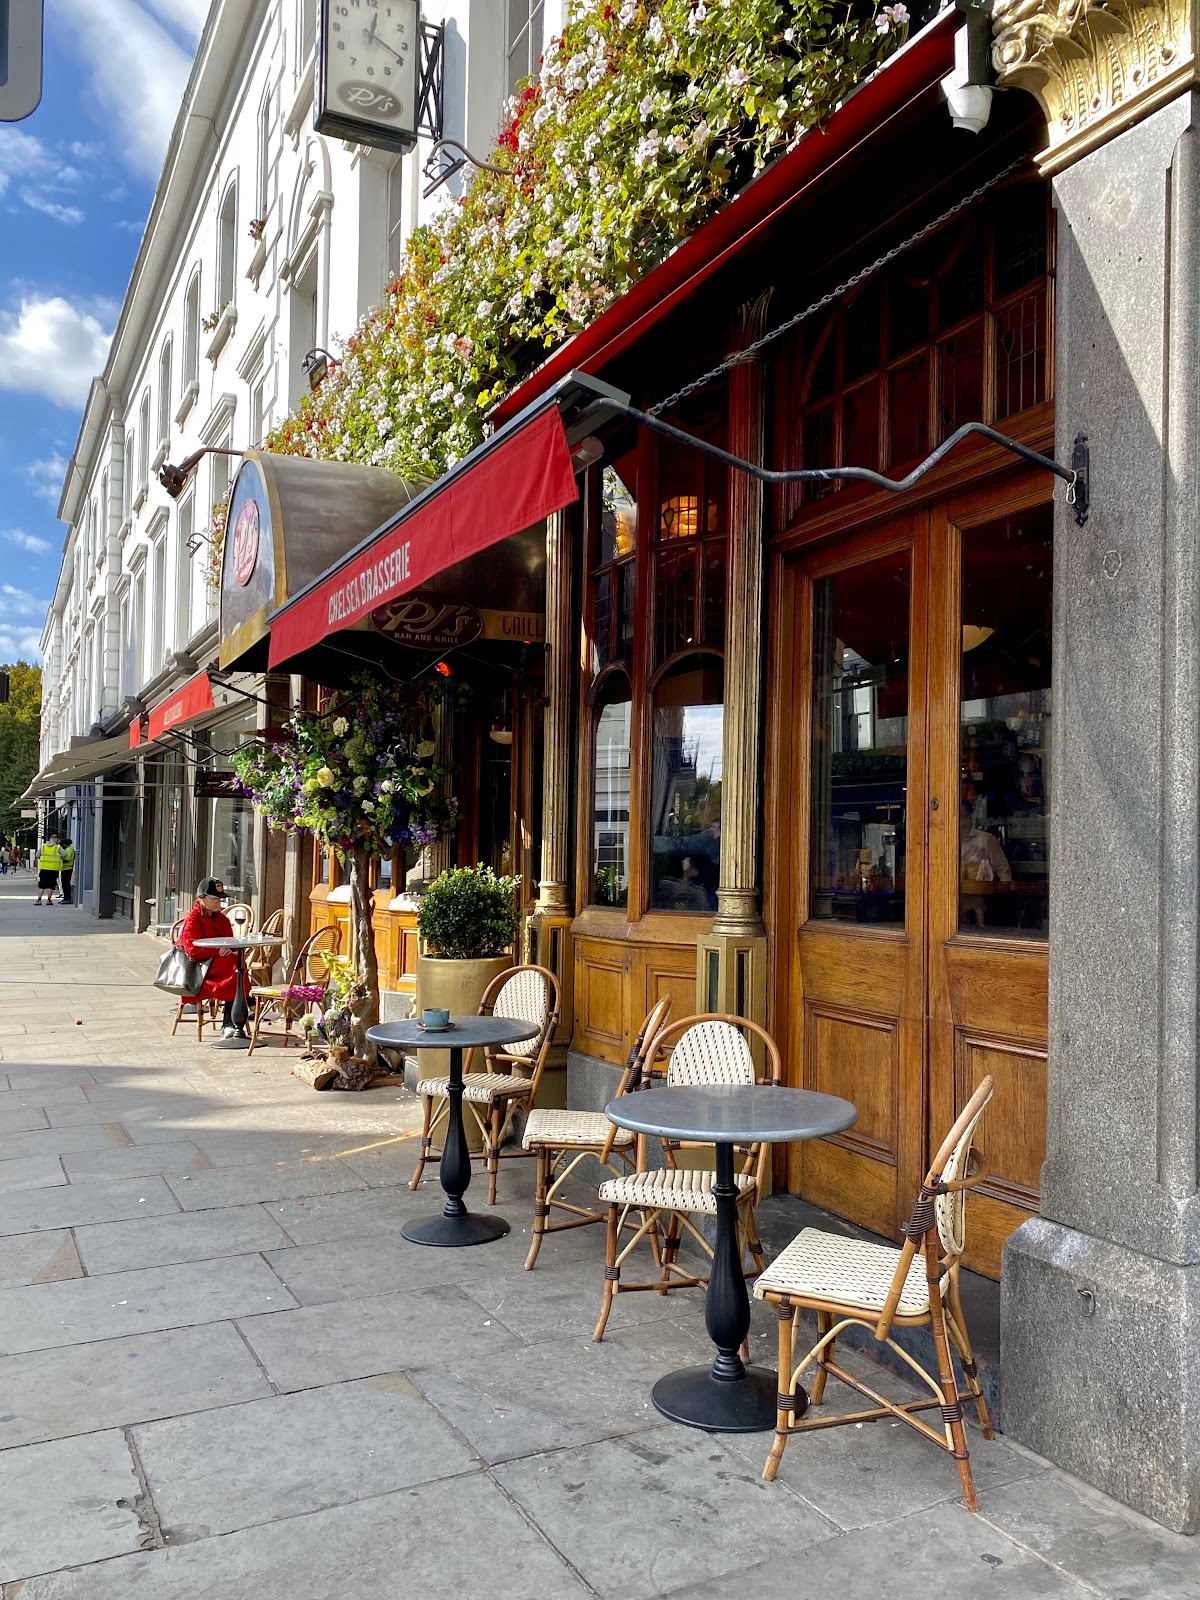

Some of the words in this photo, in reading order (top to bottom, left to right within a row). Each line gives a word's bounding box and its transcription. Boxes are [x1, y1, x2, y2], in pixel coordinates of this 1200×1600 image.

[366, 0, 378, 9] 12
[336, 6, 349, 16] 10
[386, 8, 391, 17] 1
[333, 22, 340, 31] 9
[397, 24, 405, 33] 2
[338, 41, 345, 50] 8
[401, 42, 409, 51] 3
[350, 57, 357, 66] 7
[396, 58, 404, 66] 4
[367, 67, 374, 75] 6
[384, 67, 391, 75] 5
[346, 87, 394, 112] PJ's
[328, 576, 361, 626] CHELSEA
[360, 540, 411, 606] BRASSERIE
[382, 597, 473, 636] PJ's
[502, 615, 543, 637] GRILL
[394, 632, 412, 640] BAR
[414, 633, 432, 642] AND
[434, 636, 460, 644] GRILL
